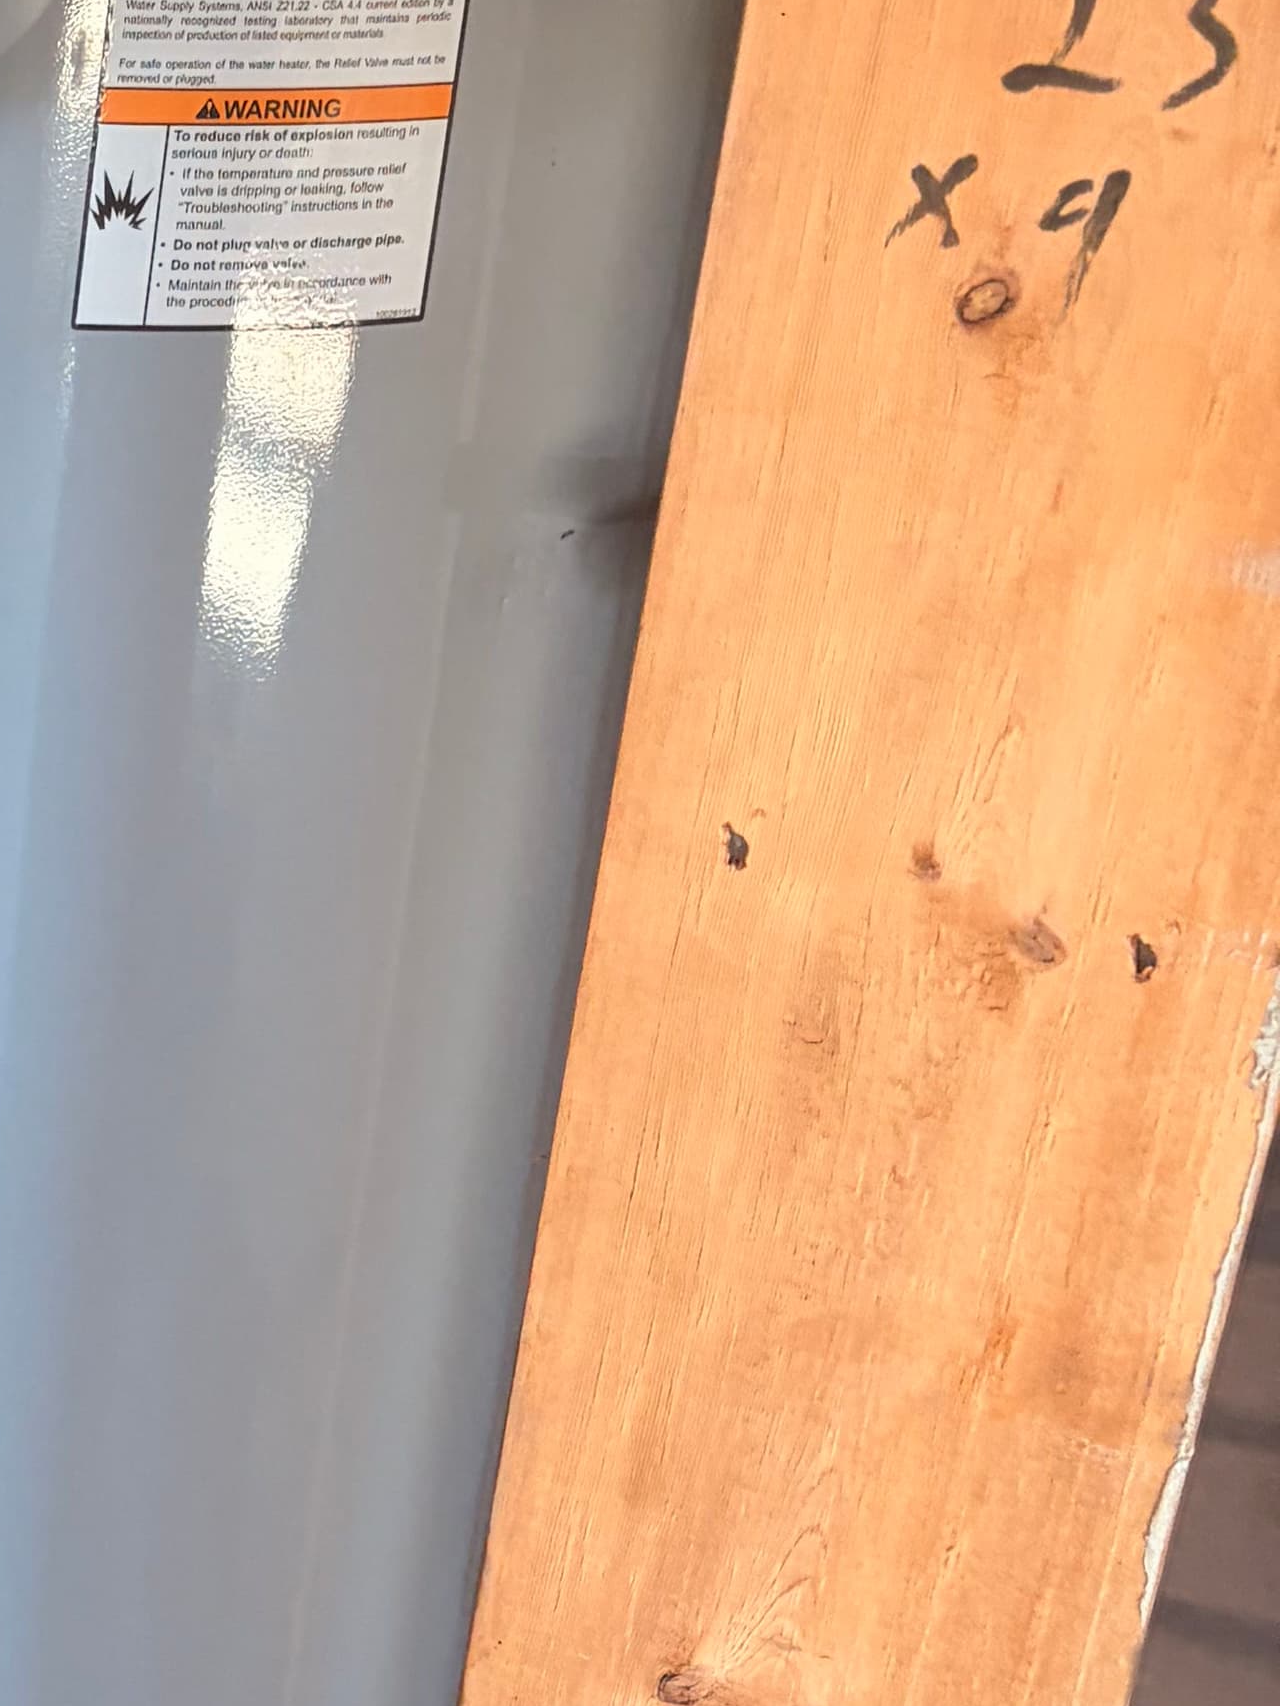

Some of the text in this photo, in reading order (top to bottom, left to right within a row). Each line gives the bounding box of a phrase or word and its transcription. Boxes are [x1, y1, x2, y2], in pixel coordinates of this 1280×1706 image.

[224, 99, 340, 118] WARNING
[174, 125, 420, 141] To reduce risk of explosion resulting in
[171, 146, 313, 161] serious injury or death:
[182, 162, 406, 179] If the temperature and pressure relief
[179, 181, 384, 198] valve is dripping or leaking, follow
[178, 198, 394, 213] "Troubleshooting" instructions in the
[175, 220, 225, 230] manual.
[172, 234, 405, 252] Do not plug valve or discharge pipe.
[170, 259, 189, 270] Do
[192, 260, 215, 270] not
[218, 260, 268, 270] remove
[167, 273, 392, 290] Maintain with
[165, 296, 186, 308] the
